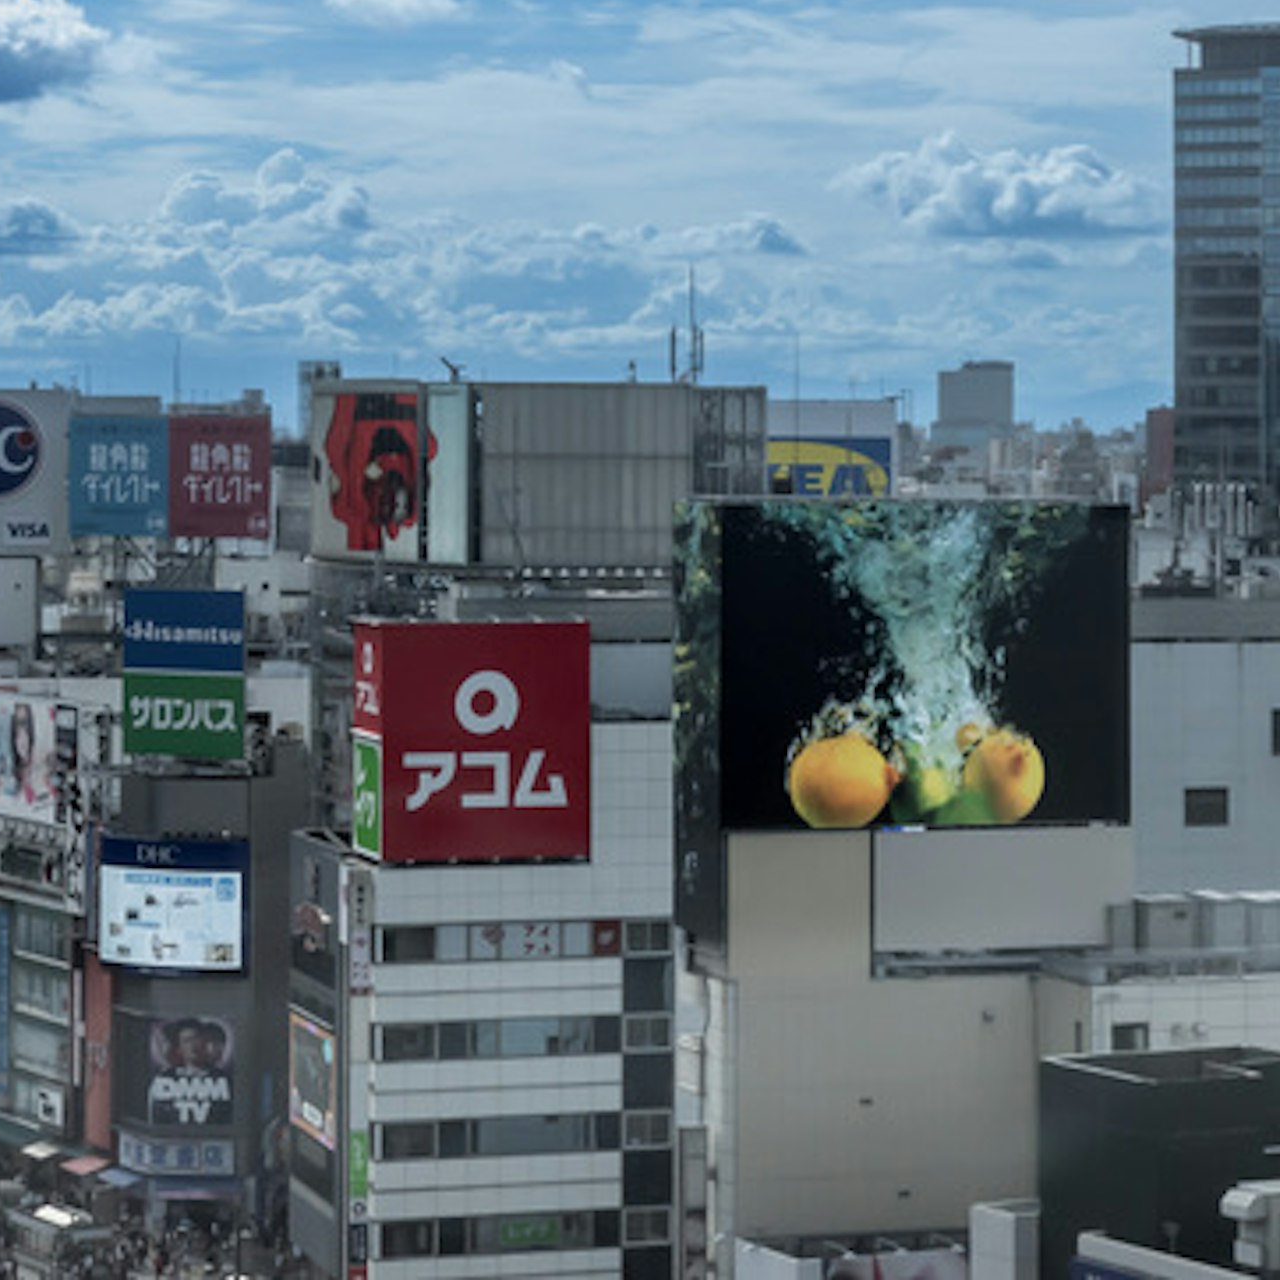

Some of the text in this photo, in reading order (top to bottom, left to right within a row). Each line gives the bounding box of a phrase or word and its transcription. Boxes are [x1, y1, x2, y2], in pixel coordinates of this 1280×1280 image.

[7, 524, 50, 538] VISA
[129, 695, 238, 733] サロンパス
[402, 750, 569, 812] アコム
[136, 844, 182, 863] DHC
[173, 1100, 211, 1124] TV
